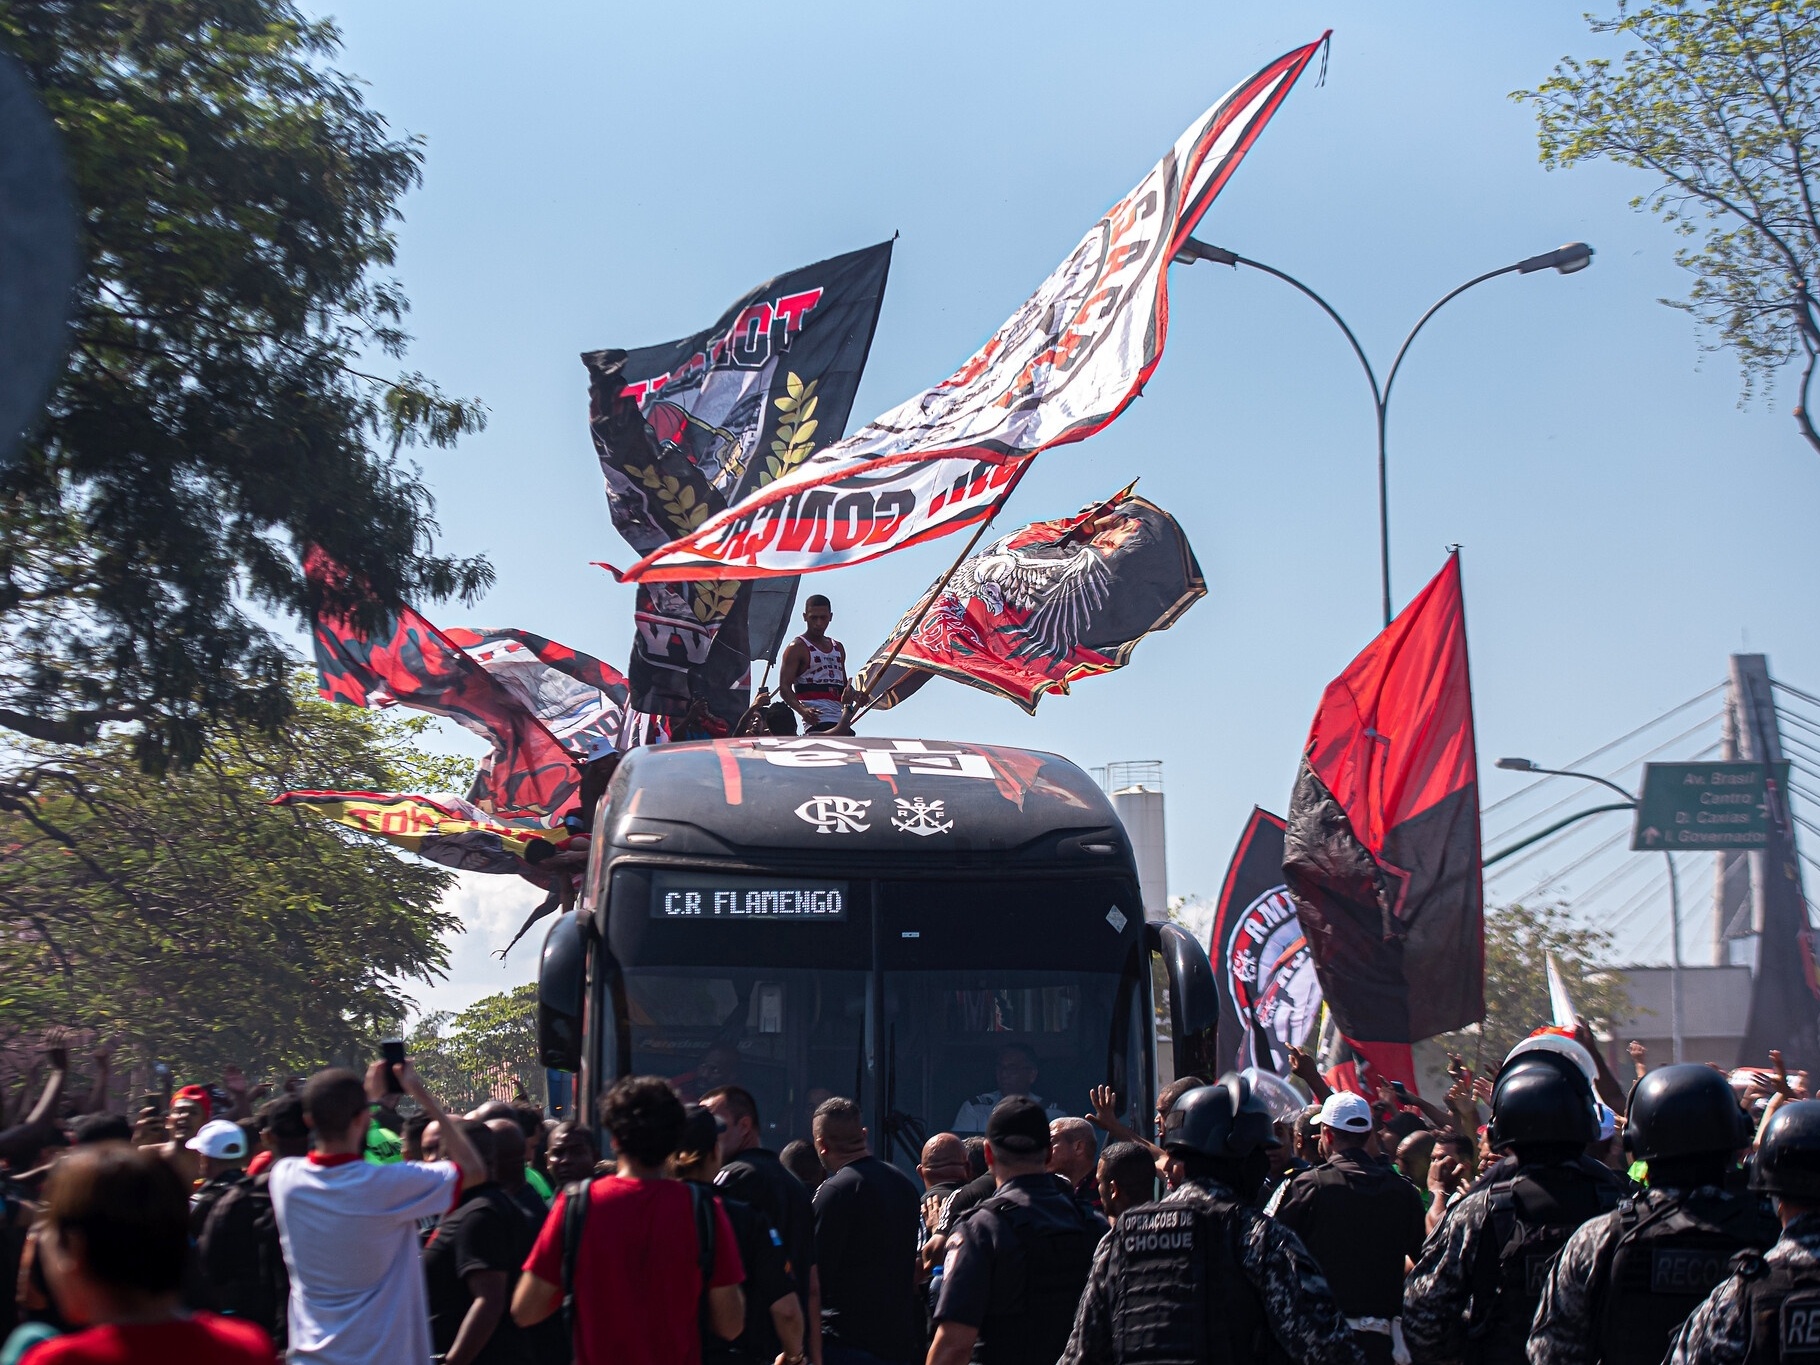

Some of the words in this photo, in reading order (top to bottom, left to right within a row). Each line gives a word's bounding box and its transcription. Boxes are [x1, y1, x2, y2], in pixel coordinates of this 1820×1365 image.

[1711, 771, 1757, 784] Brasil
[1700, 791, 1753, 805] Centro
[1695, 810, 1749, 824] Caxias
[665, 892, 701, 914] C.R
[714, 890, 842, 914] FLAMENGO
[1180, 1211, 1193, 1227] DE
[1124, 1232, 1193, 1253] CHOQUE
